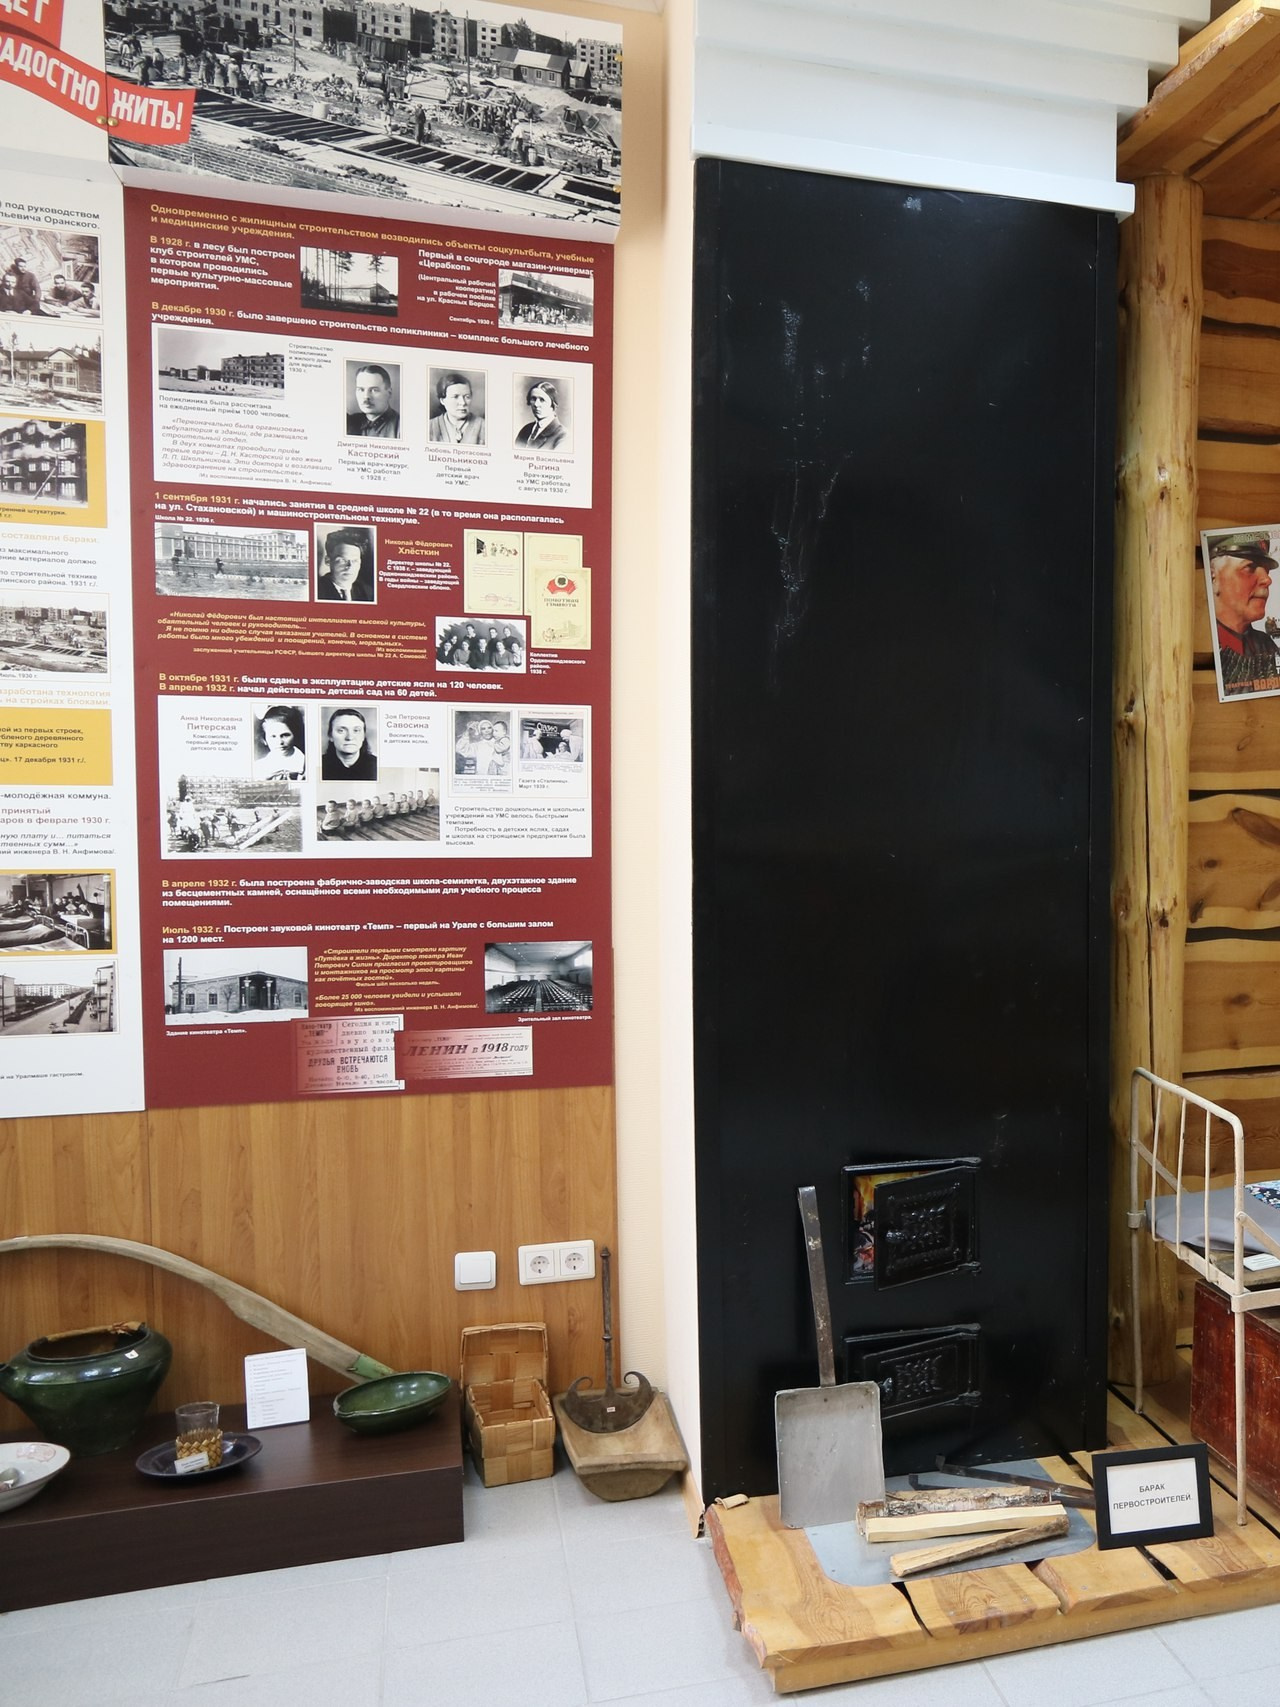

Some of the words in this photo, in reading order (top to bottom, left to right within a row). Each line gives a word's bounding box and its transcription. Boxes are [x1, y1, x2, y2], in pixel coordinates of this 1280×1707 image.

[0, 35, 100, 110] АДОСТНО
[112, 88, 184, 130] ЖИТЬ!
[5, 202, 25, 211] под
[27, 206, 100, 219] руководством
[44, 217, 100, 228] Оранского.
[160, 218, 230, 231] медицинские
[232, 227, 295, 238] учреждения.
[151, 205, 229, 220] Одновременно
[240, 217, 297, 228] жилищным
[299, 225, 379, 238] строительством
[381, 234, 443, 246] возводились
[445, 241, 486, 250] объекты
[488, 246, 554, 258] соцкультбыта,
[556, 254, 594, 263] учебные
[161, 237, 183, 246] 1928
[202, 244, 226, 253] лесу
[227, 245, 249, 254] был
[251, 249, 296, 259] построен
[150, 248, 174, 256] клуб
[176, 251, 233, 261] строителей
[235, 256, 259, 265] УМС,
[418, 250, 454, 260] Первый
[464, 257, 510, 266] соцгороде
[159, 259, 201, 268] котором
[203, 264, 269, 275] проводились
[419, 260, 471, 270] «Церабкоп»
[151, 267, 189, 276] первые
[191, 272, 293, 287] культурно-массовые
[151, 278, 219, 289] мероприятия.
[152, 314, 214, 324] учреждения.
[161, 305, 202, 314] декабре
[205, 308, 227, 316] 1930
[237, 311, 264, 320] было
[265, 315, 318, 325] завершено
[319, 321, 388, 332] строительство
[390, 328, 449, 337] поликлиники
[458, 334, 499, 342] комплекс
[501, 337, 544, 347] большого
[545, 342, 590, 351] лечебного
[348, 450, 400, 459] Касторский
[428, 455, 488, 465] Школьникова
[528, 463, 560, 471] Рыгина
[162, 494, 208, 505] сентября
[242, 499, 288, 508] начались
[406, 507, 417, 515] №
[419, 508, 429, 516] 22
[431, 509, 440, 517] (в
[500, 515, 565, 523] располагалась
[398, 547, 440, 555] Хлёсткин
[159, 673, 167, 681] В
[168, 674, 208, 682] октябре
[206, 684, 227, 692] 1932
[187, 723, 237, 731] Питерская
[239, 879, 265, 887] была
[316, 879, 411, 888] фабрично-заводская
[412, 879, 490, 887] школа-семилетка,
[162, 927, 190, 935] Июль
[270, 924, 313, 933] звуковой
[404, 922, 438, 930] первый
[481, 1039, 508, 1052] 1918
[340, 1055, 388, 1065] ВСТРЕЧАЮТСЯ
[1139, 1484, 1165, 1493] БАРАК
[1113, 1495, 1191, 1509] ПЕРВОСТРОИТЕЛЕЙ
